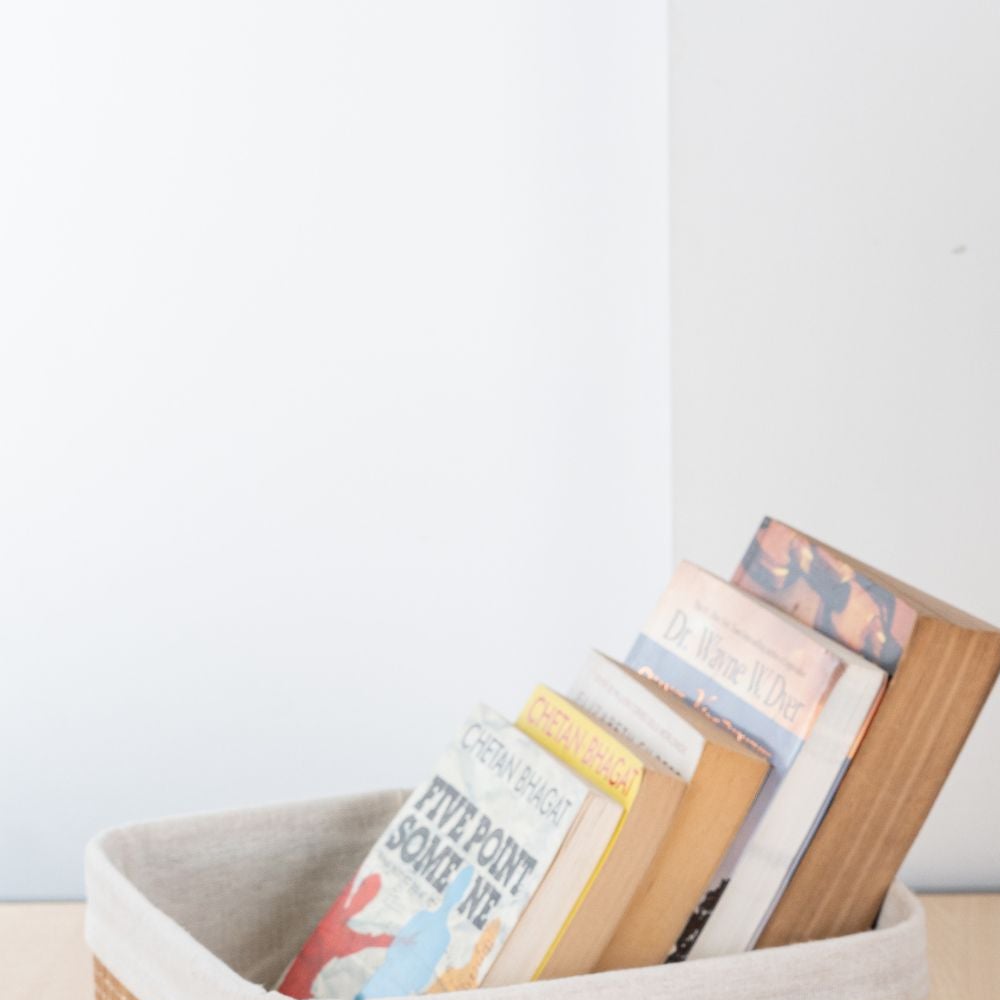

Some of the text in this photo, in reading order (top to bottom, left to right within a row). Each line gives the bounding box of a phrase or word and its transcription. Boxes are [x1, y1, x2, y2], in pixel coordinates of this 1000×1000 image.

[461, 722, 520, 781] CHETAN
[514, 765, 573, 826] BHAGAT
[527, 696, 585, 756] CHETAN
[580, 737, 639, 796] BHAGAT
[413, 775, 479, 843] FIVE
[463, 814, 539, 896] POINT
